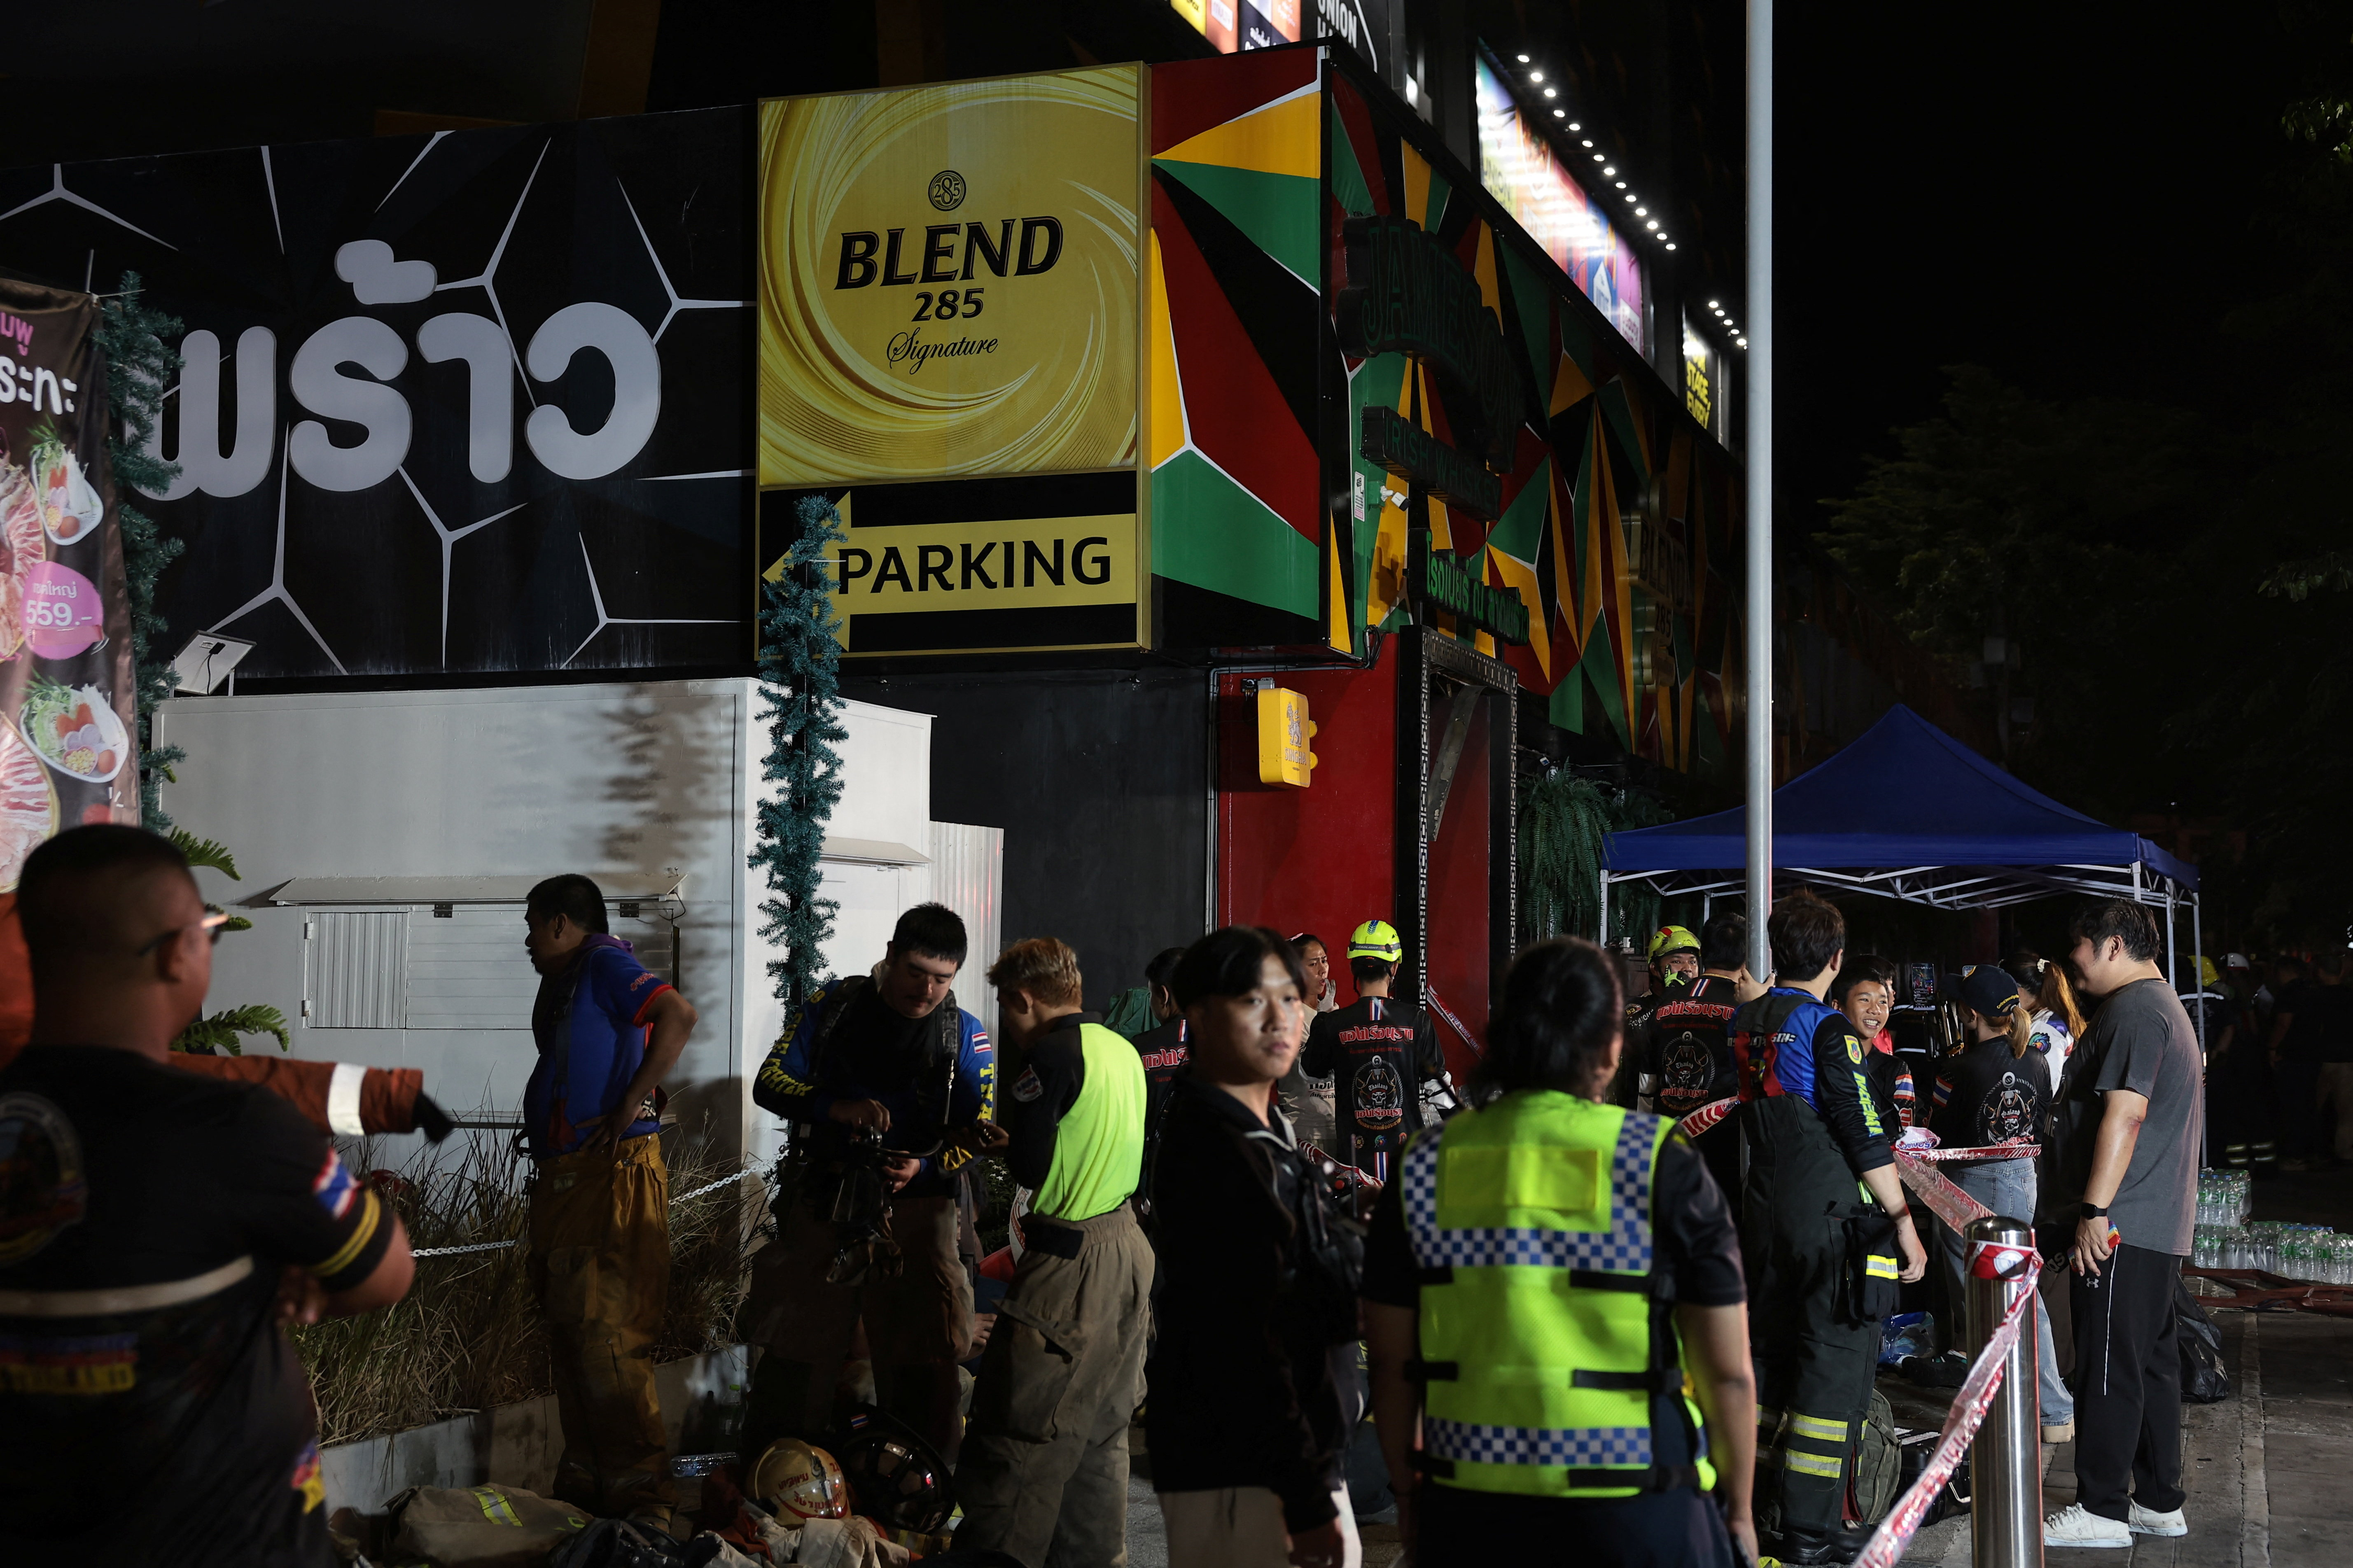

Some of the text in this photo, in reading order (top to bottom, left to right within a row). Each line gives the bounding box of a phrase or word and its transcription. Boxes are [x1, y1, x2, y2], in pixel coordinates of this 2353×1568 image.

[934, 177, 960, 205] 285
[834, 215, 1064, 290] BLEND
[911, 288, 985, 322] 285
[887, 327, 999, 375] Signature
[1385, 415, 1429, 472] IRISH
[1436, 449, 1501, 513] WHISKEY
[838, 537, 1111, 595] PARKING
[1285, 747, 1307, 766] SINGHA
[1368, 1083, 1389, 1092] Thailand
